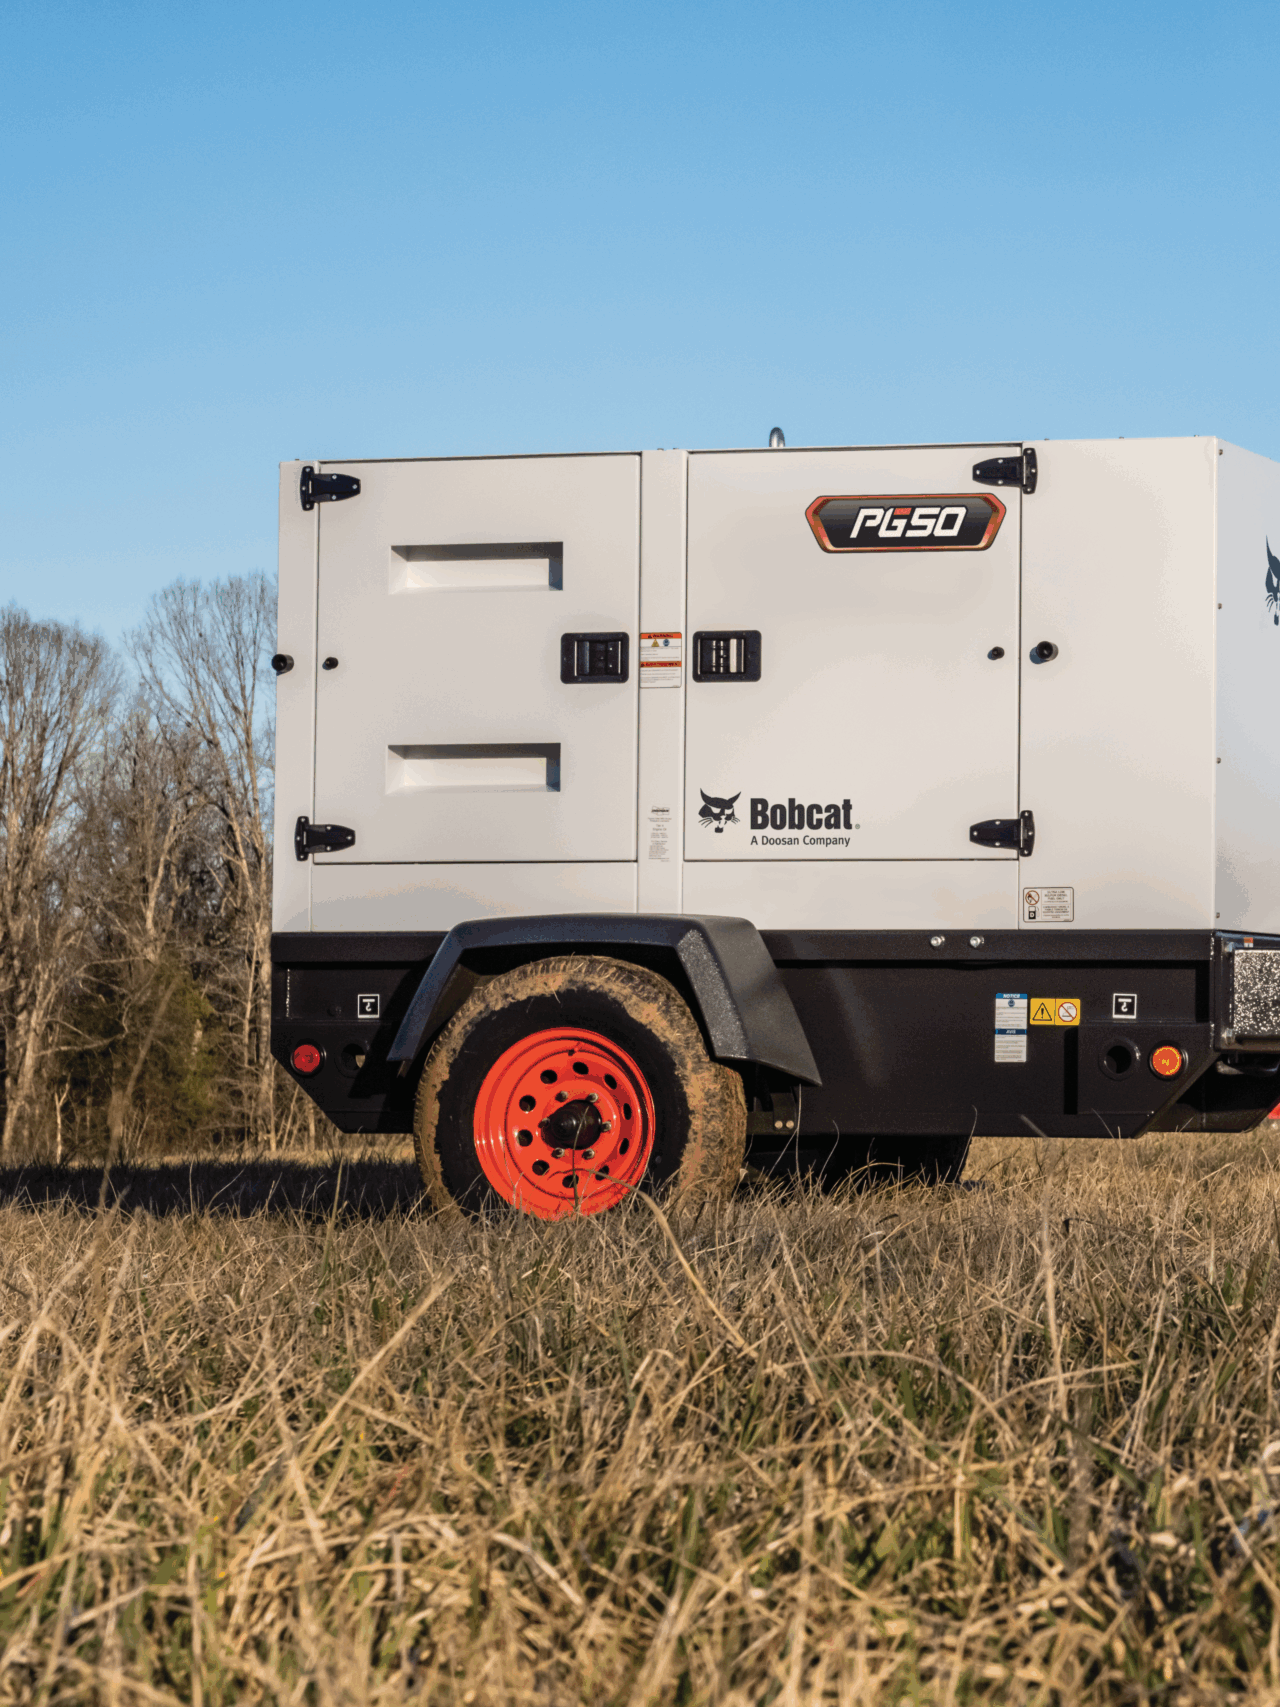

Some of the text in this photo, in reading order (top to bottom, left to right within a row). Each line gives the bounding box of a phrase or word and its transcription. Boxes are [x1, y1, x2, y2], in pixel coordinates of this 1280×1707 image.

[849, 506, 968, 538] PG50
[750, 798, 853, 831] Bobcat
[750, 835, 851, 847] A Doosan Company
